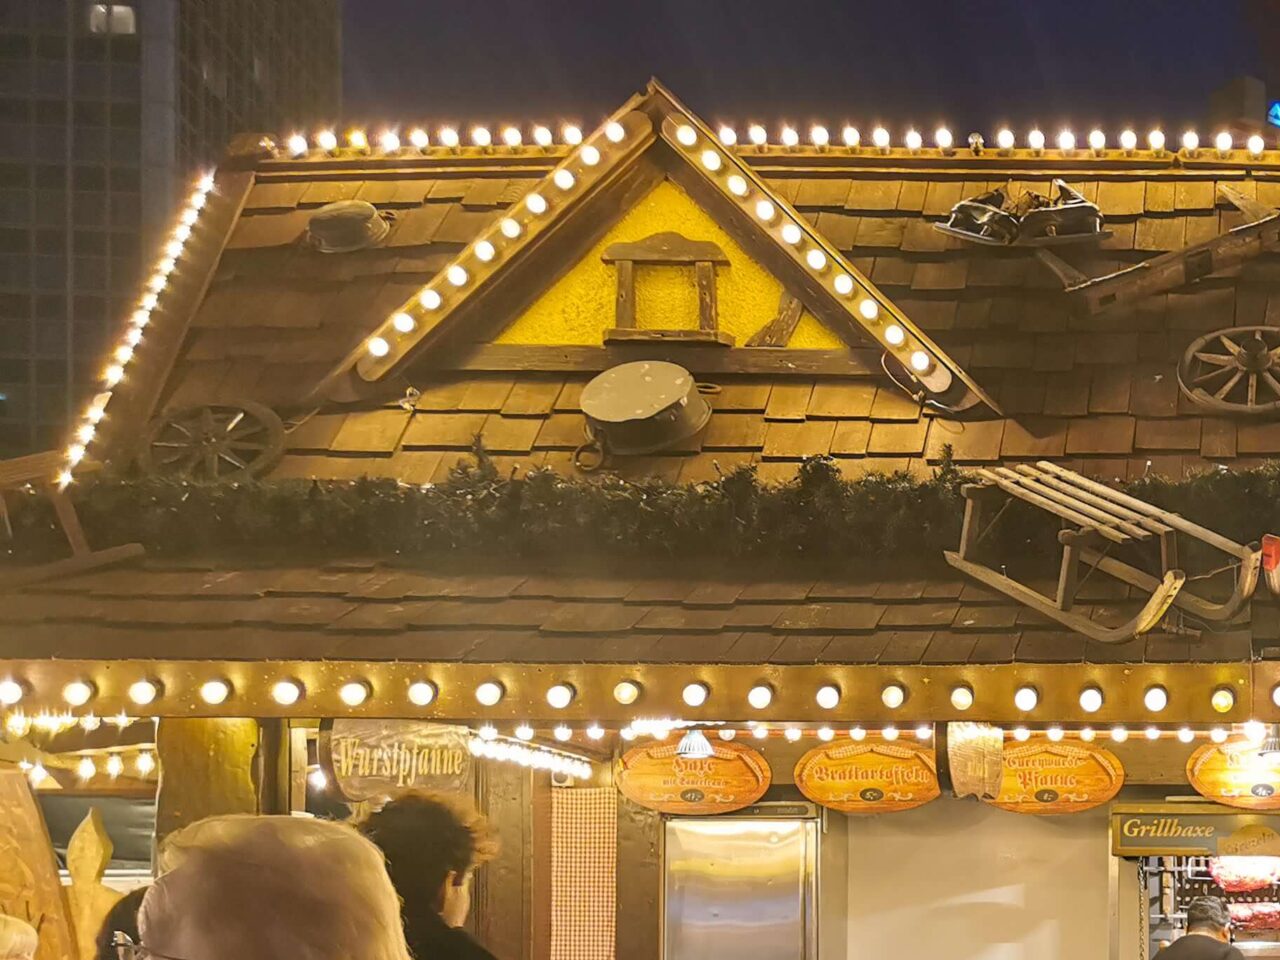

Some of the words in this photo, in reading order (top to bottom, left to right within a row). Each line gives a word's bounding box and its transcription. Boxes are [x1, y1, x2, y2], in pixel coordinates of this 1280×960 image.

[338, 738, 463, 788] Wurstpfanne
[813, 764, 931, 786] Bratkartoffeln
[1017, 770, 1078, 792] Pfanne
[1122, 817, 1215, 838] Grillhaxe
